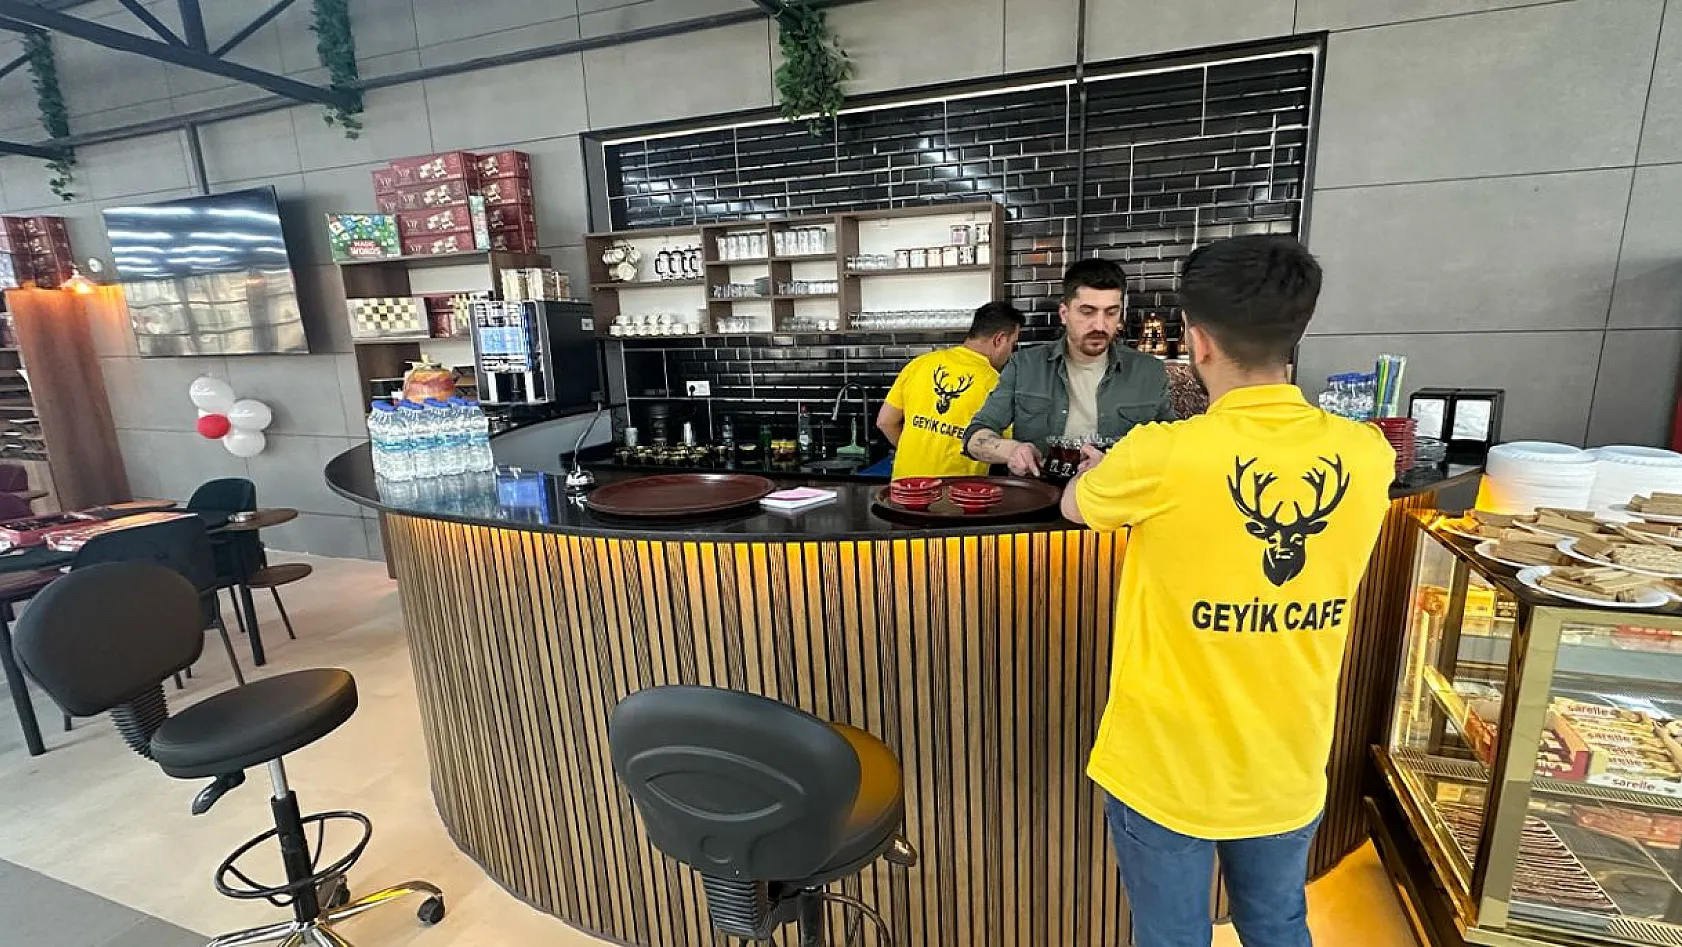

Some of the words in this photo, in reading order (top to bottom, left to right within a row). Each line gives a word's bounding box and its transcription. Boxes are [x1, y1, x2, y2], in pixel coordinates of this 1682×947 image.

[940, 422, 965, 440] CAFE
[1191, 597, 1278, 632] GEYİK
[1283, 598, 1347, 631] CAFE
[1568, 704, 1609, 716] sarelle
[1612, 778, 1656, 791] sarelle
